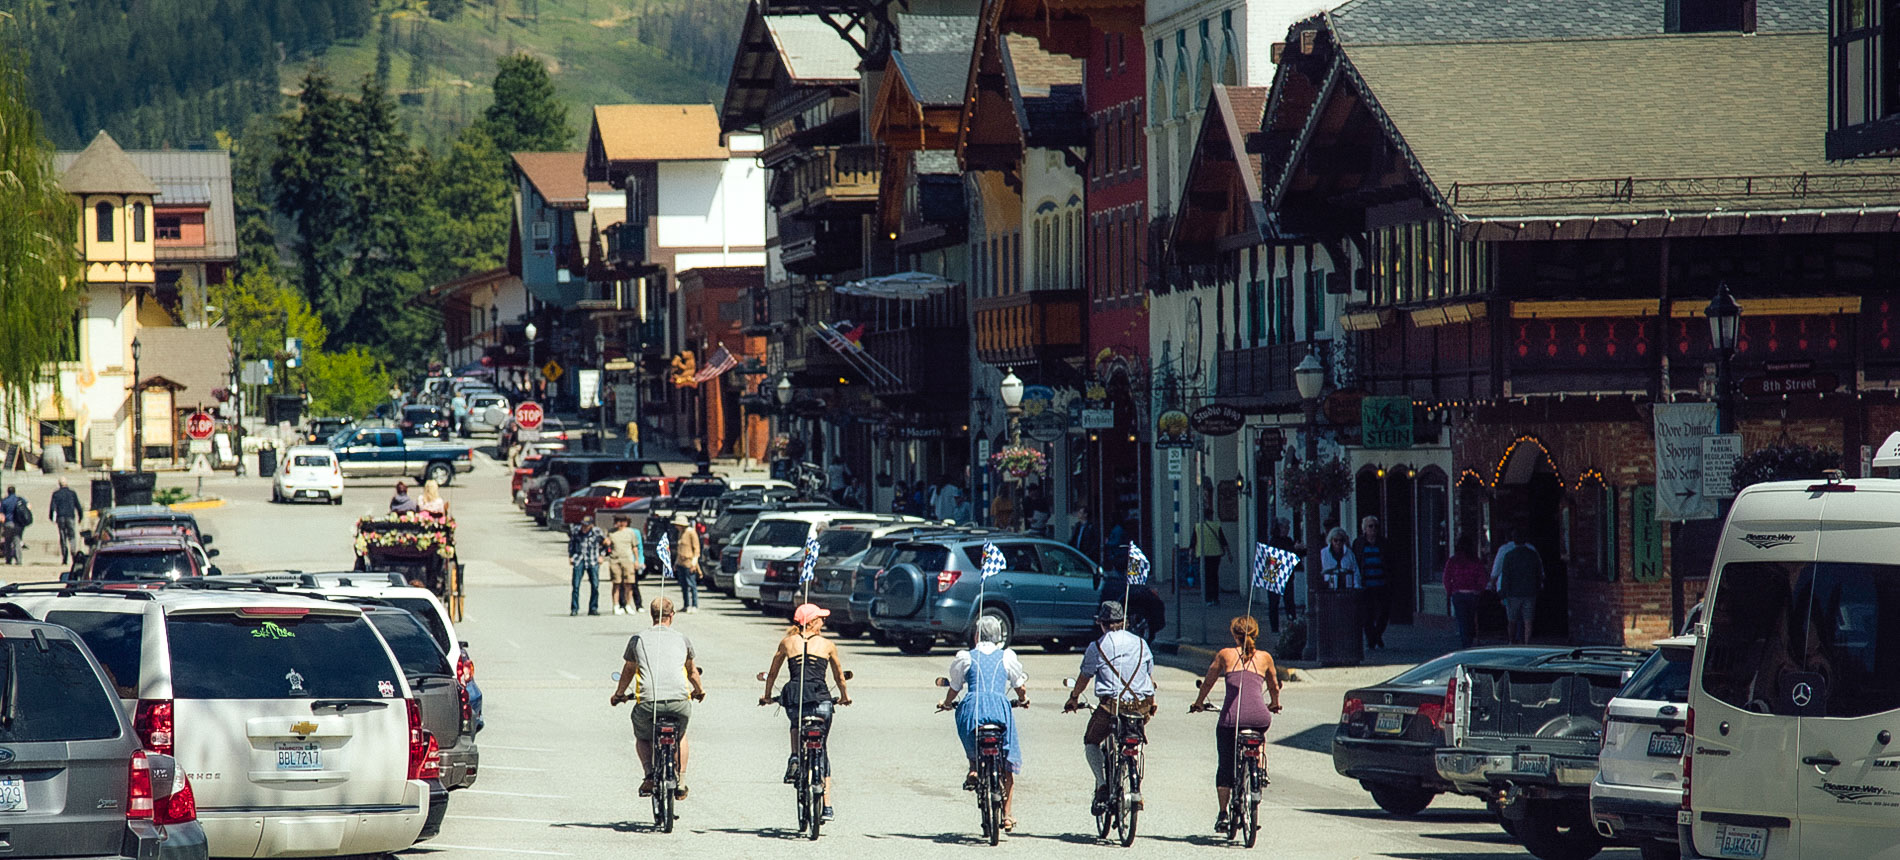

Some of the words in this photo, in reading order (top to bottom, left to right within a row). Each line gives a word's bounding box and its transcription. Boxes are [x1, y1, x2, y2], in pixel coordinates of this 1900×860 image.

[1763, 380, 1781, 392] 8th
[1785, 378, 1816, 391] Street
[518, 410, 541, 421] STOP
[1193, 407, 1222, 424] Studio
[1367, 429, 1410, 444] STEIN
[1658, 422, 1682, 437] More
[1712, 438, 1731, 446] WINTER
[1666, 442, 1701, 461] Shoppin
[1660, 465, 1678, 481] and
[1641, 490, 1656, 578] STEIN
[278, 751, 319, 765] BBL7217
[187, 772, 221, 780] AHOE
[1823, 782, 1884, 795] Pleasure-Way
[1725, 836, 1761, 854] BJX4241
